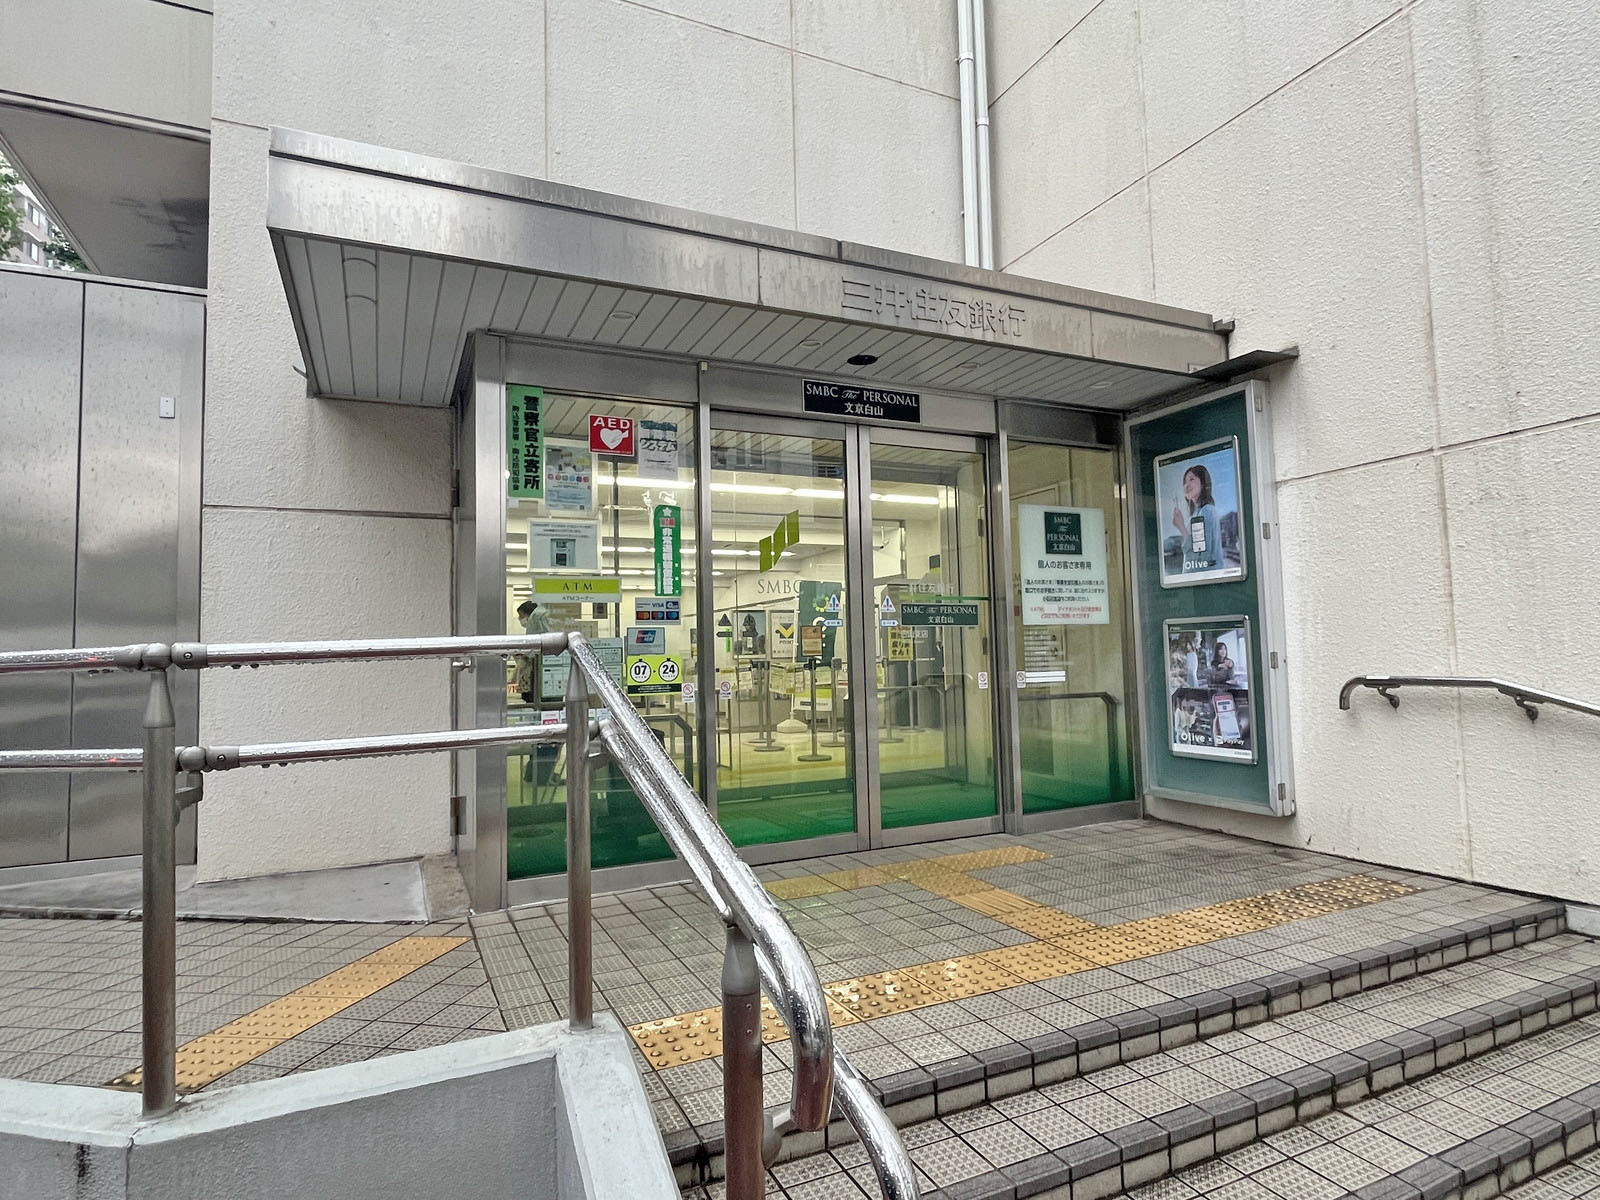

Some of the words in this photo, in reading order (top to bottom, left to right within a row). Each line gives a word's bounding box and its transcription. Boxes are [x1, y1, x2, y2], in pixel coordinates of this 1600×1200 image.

[842, 276, 1025, 337] 三井住友銀行
[806, 383, 839, 398] SMBC
[841, 389, 860, 400] The
[863, 390, 918, 407] PERSONAL
[844, 402, 884, 416] 文京白山
[593, 417, 630, 429] AED
[524, 395, 540, 490] 警察官立寄所
[1047, 533, 1079, 542] PERSONAL
[1038, 560, 1092, 570] 個人のお客さま専用
[1184, 560, 1208, 570] Olive
[562, 582, 593, 591] ATM
[903, 606, 924, 614] SMBC
[940, 606, 977, 614] PERSONAL
[927, 616, 954, 624] 文京白山
[634, 665, 647, 675] 07
[662, 664, 676, 674] 24
[1181, 732, 1206, 743] Olive
